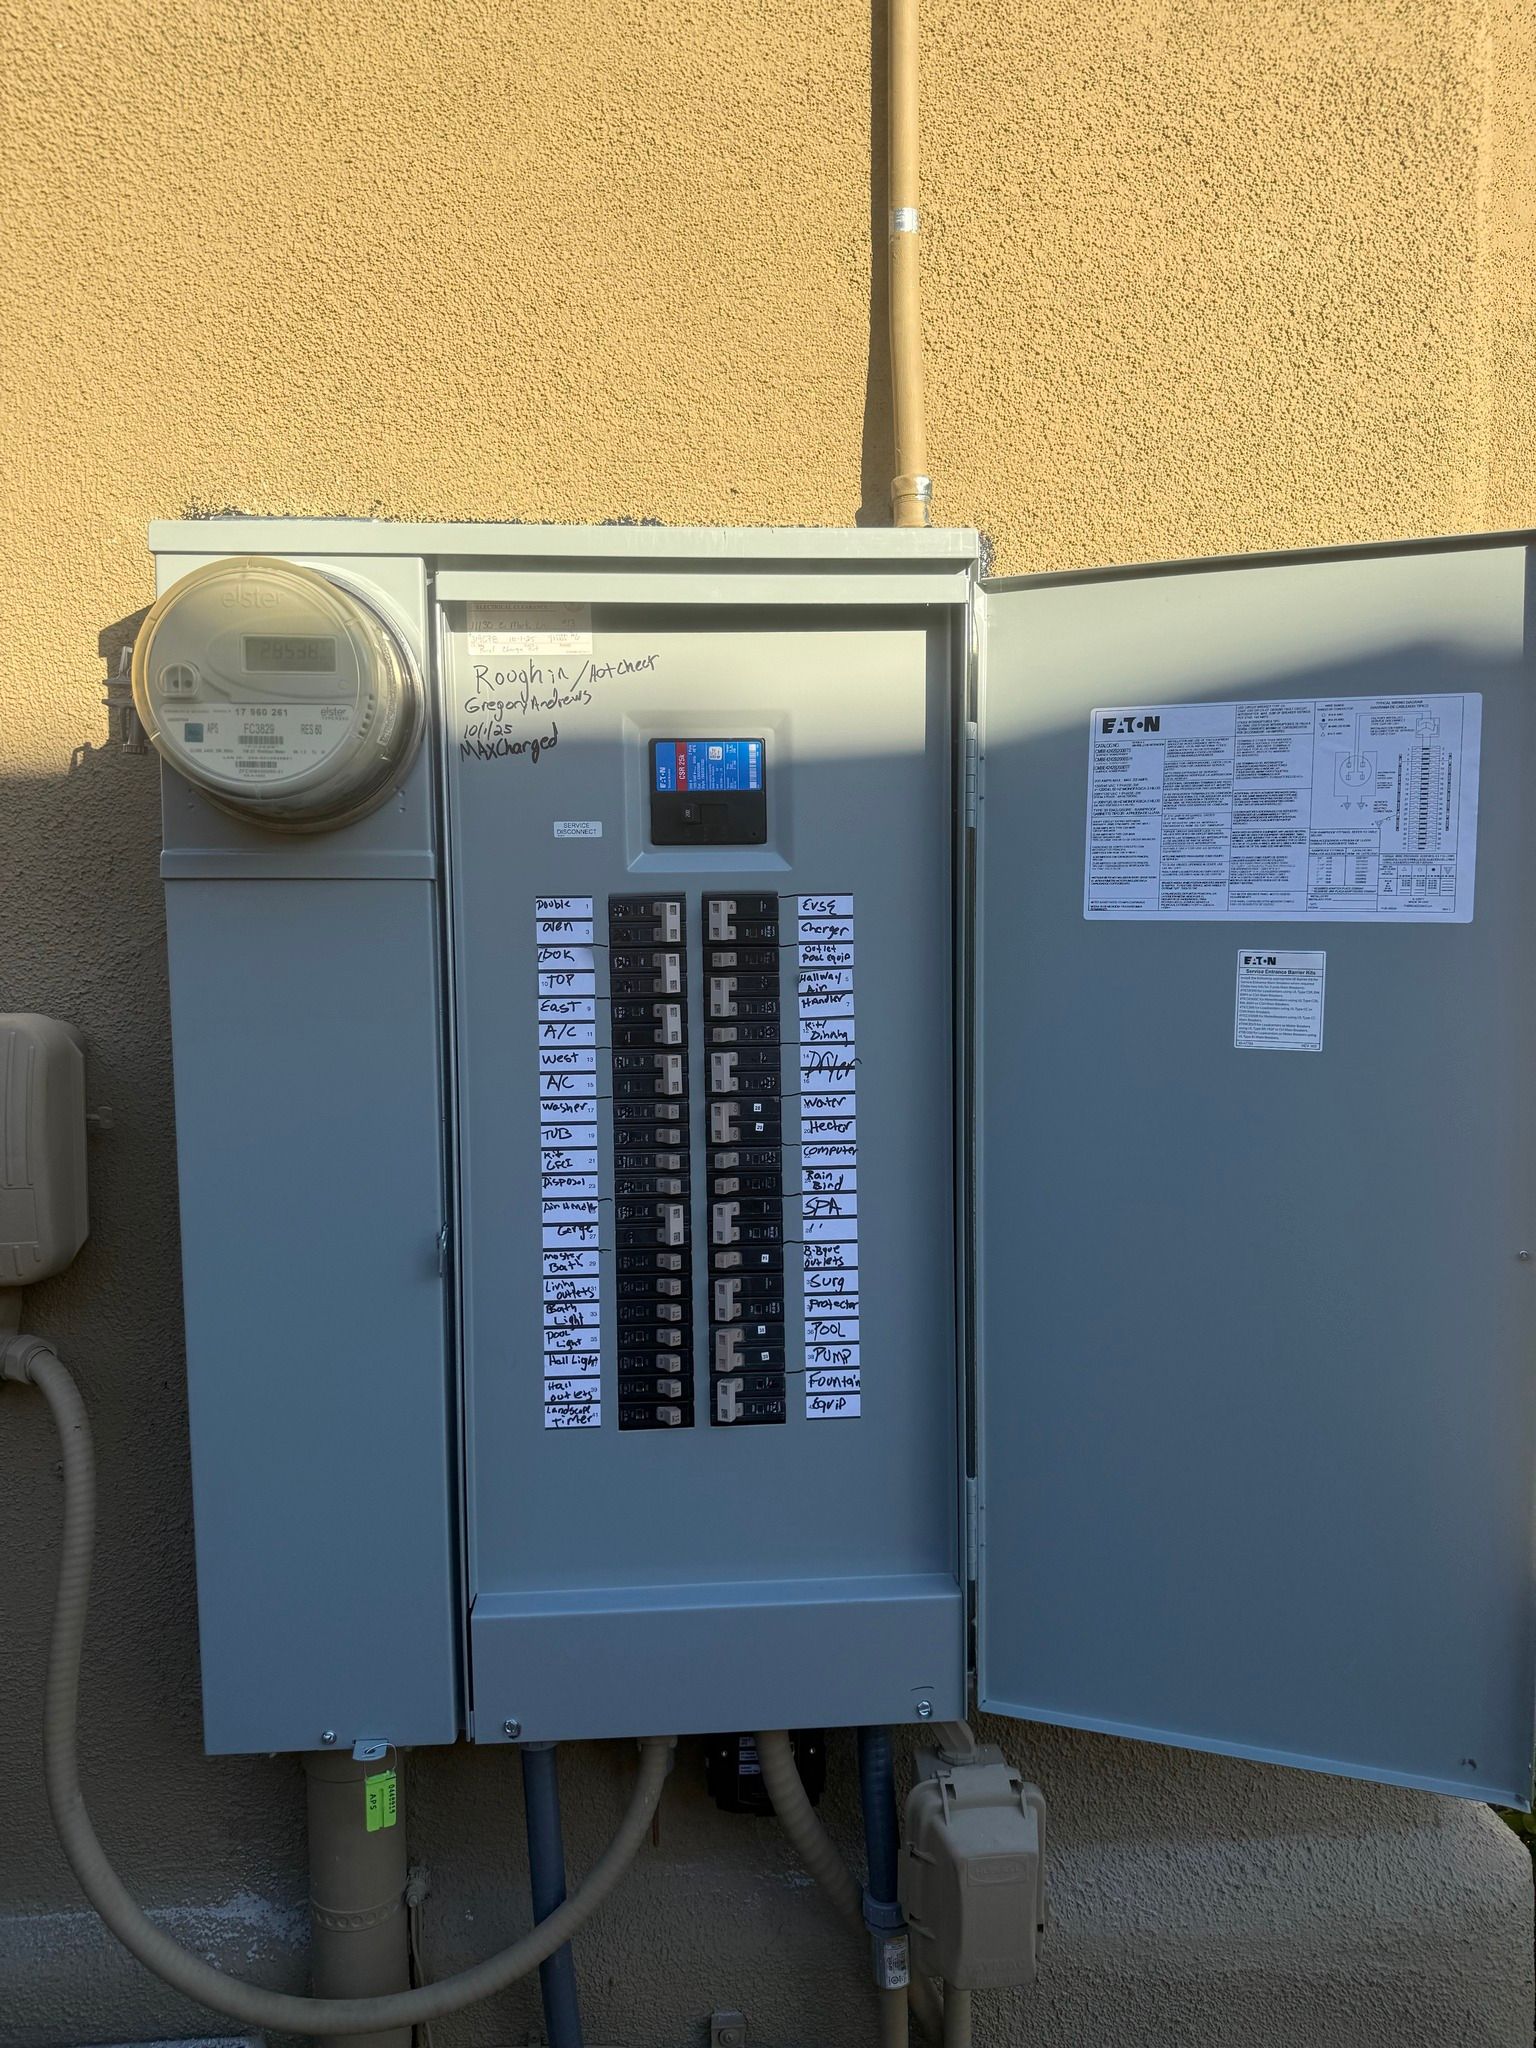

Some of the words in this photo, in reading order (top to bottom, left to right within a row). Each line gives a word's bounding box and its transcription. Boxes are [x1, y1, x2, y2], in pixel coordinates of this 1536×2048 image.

[474, 658, 543, 701] Rough
[1102, 716, 1160, 734] EATON
[1244, 956, 1276, 965] EATON
[547, 974, 575, 988] TOP
[544, 1024, 577, 1040] A/C
[547, 1075, 574, 1091] A/C
[542, 1128, 572, 1139] TUB
[803, 1197, 842, 1215] SPA
